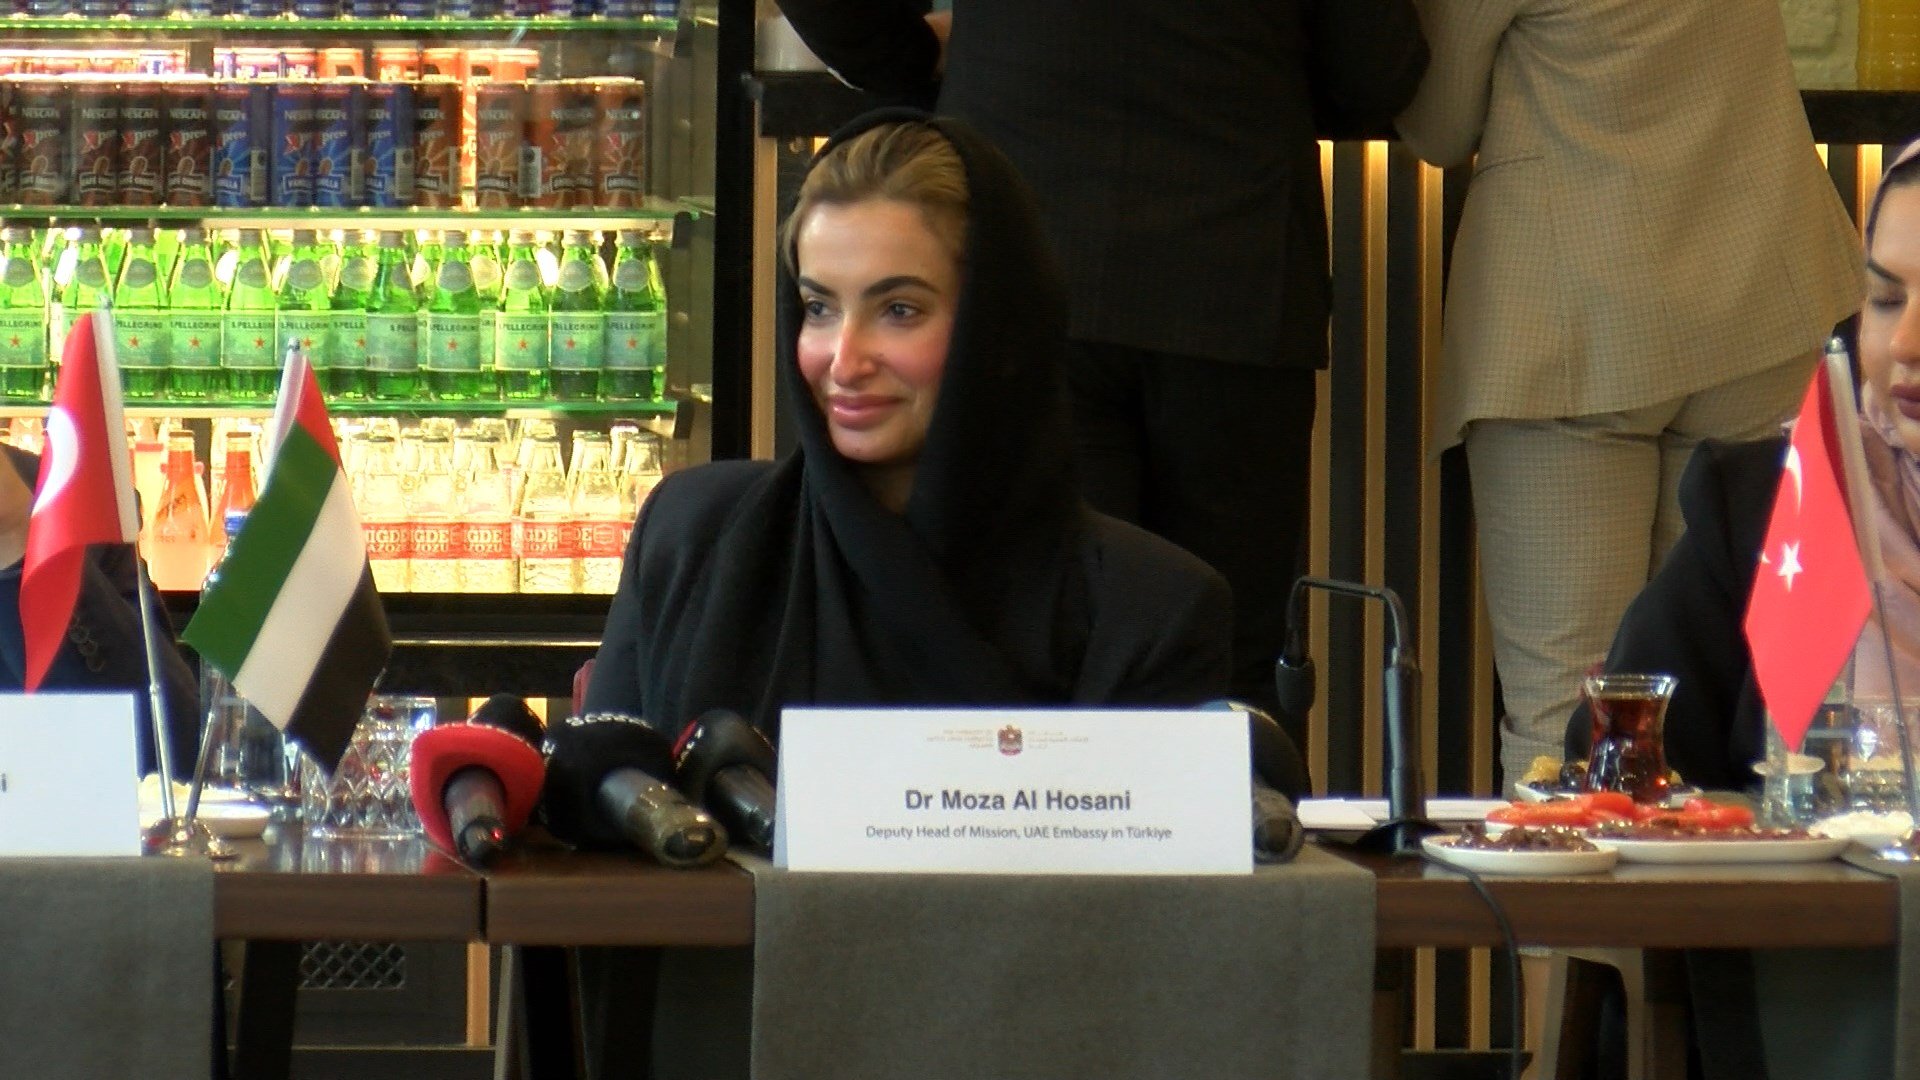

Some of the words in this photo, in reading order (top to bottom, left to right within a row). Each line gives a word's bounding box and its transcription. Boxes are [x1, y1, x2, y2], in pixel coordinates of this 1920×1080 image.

[905, 789, 933, 811] Dr
[941, 789, 1005, 811] Moza
[1012, 788, 1038, 811] Al
[1045, 788, 1131, 811] Hosani
[865, 825, 913, 842] Deputy
[916, 825, 950, 839] Head
[953, 825, 967, 839] of
[969, 825, 1021, 842] Mission,
[1023, 826, 1050, 840] UAE
[1052, 825, 1108, 842] Embassy
[1110, 826, 1124, 840] in
[1126, 825, 1173, 842] Türkiye
